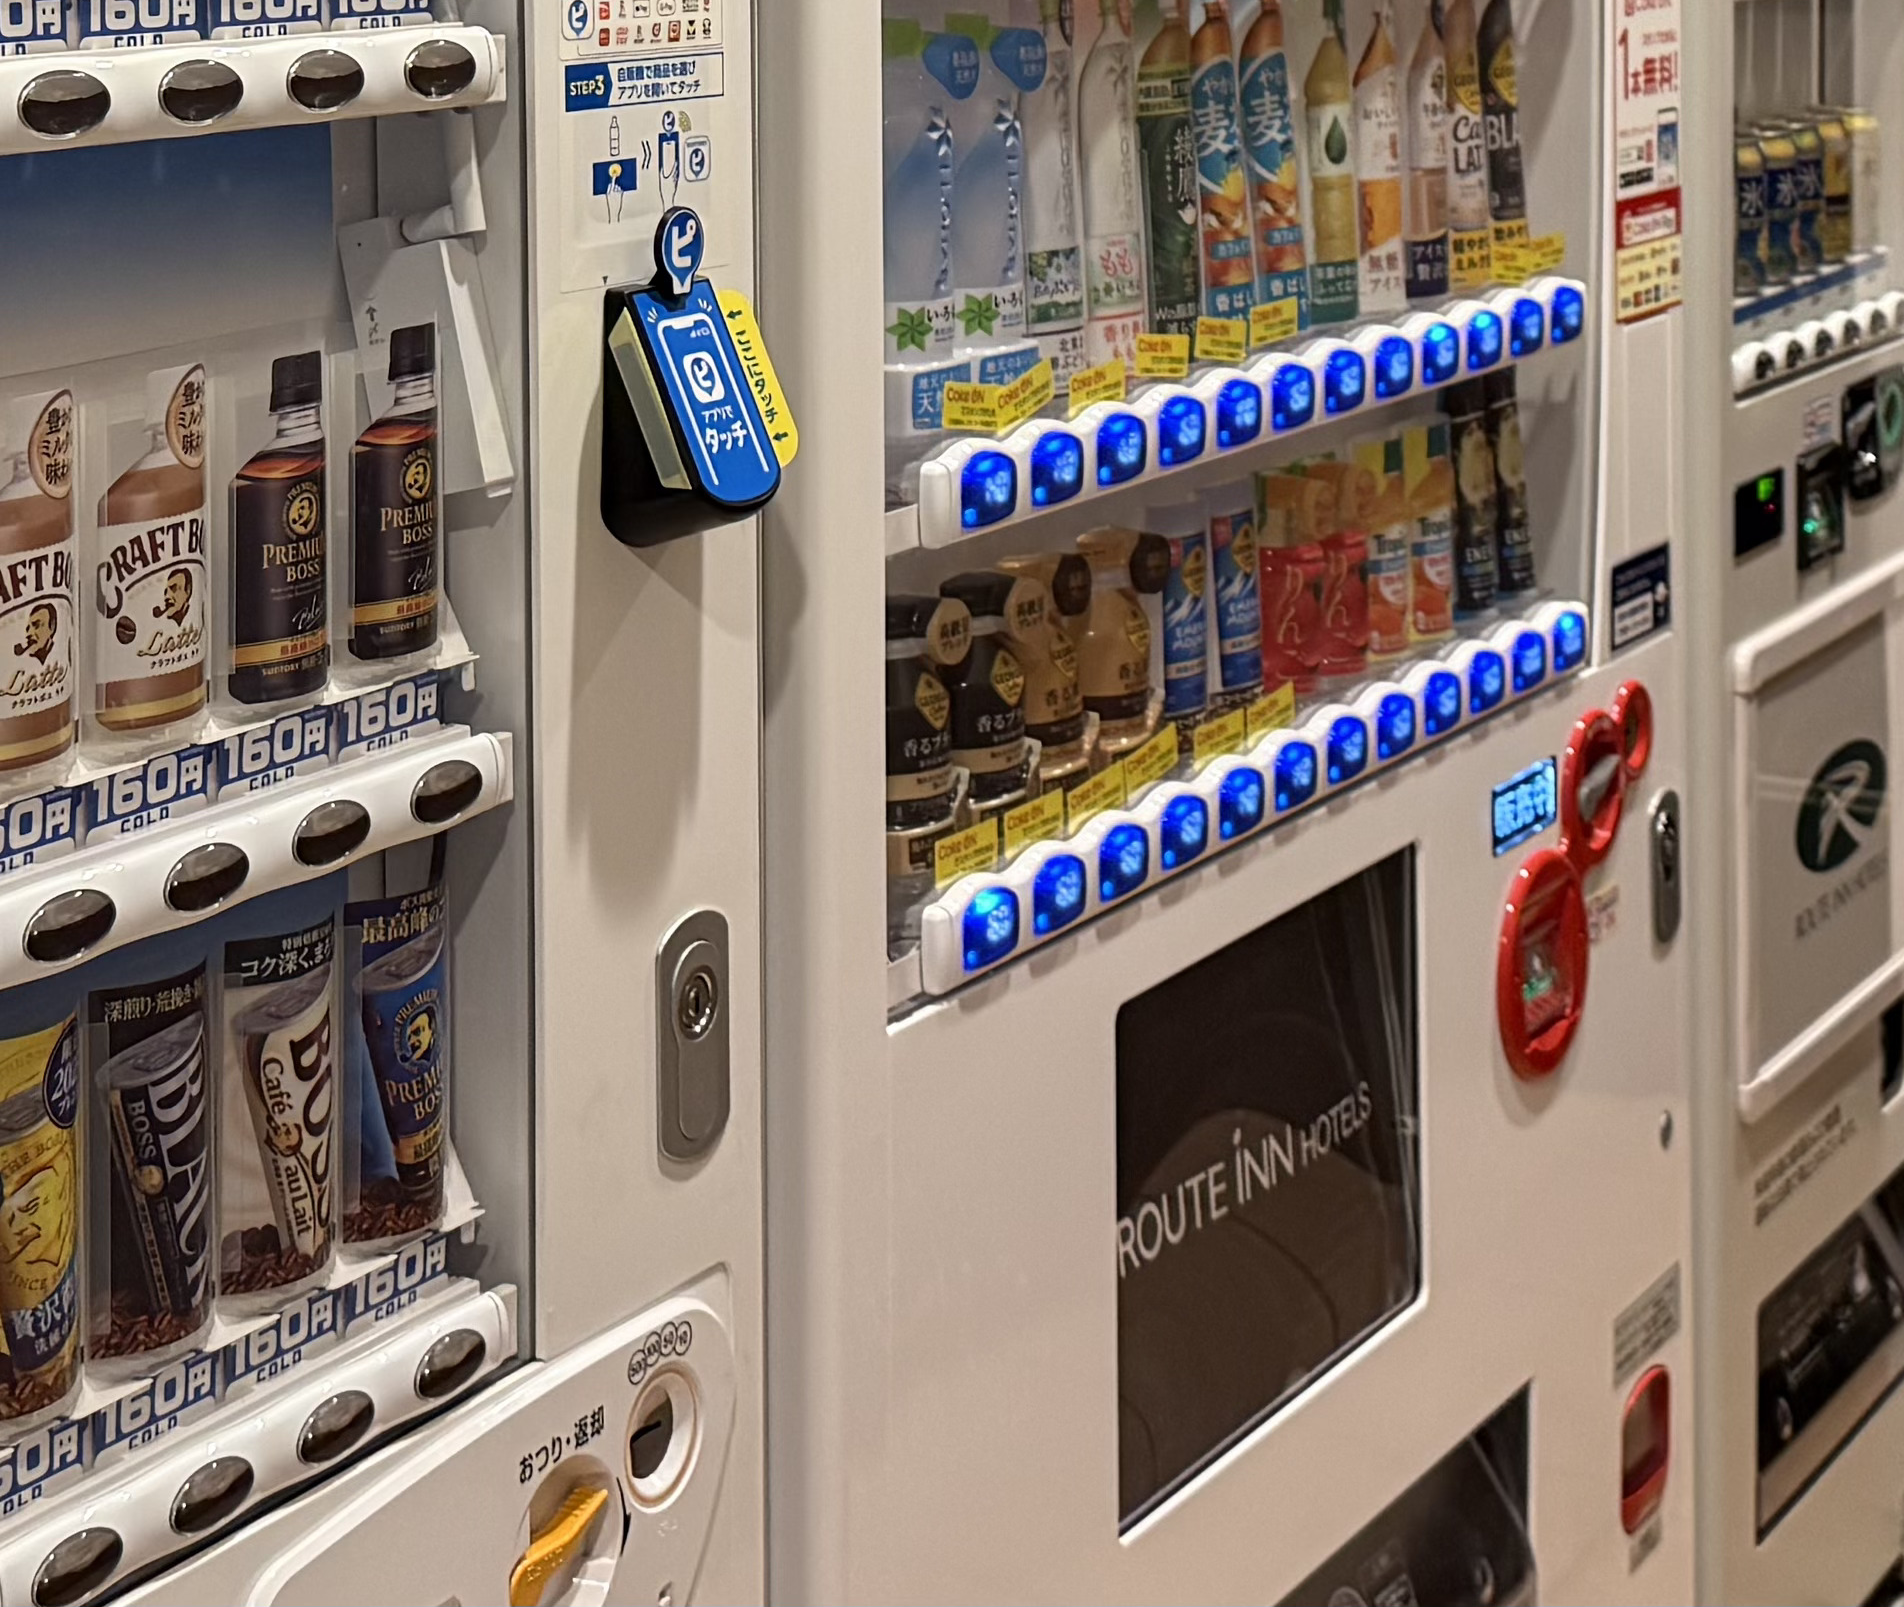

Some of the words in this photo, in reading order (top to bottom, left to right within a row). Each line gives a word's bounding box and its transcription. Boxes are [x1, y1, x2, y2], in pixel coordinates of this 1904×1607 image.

[570, 75, 605, 96] STEP3
[672, 219, 697, 268] ピ
[735, 329, 779, 425] ここにタッチ
[705, 424, 748, 455] タッチ
[98, 522, 185, 619] CRAFT
[1116, 1162, 1228, 1279] ROUTE
[1234, 1126, 1296, 1205] INN
[1300, 1080, 1373, 1168] HOTELS
[129, 1414, 178, 1451] COLD
[518, 1407, 605, 1484] おつり・返却
